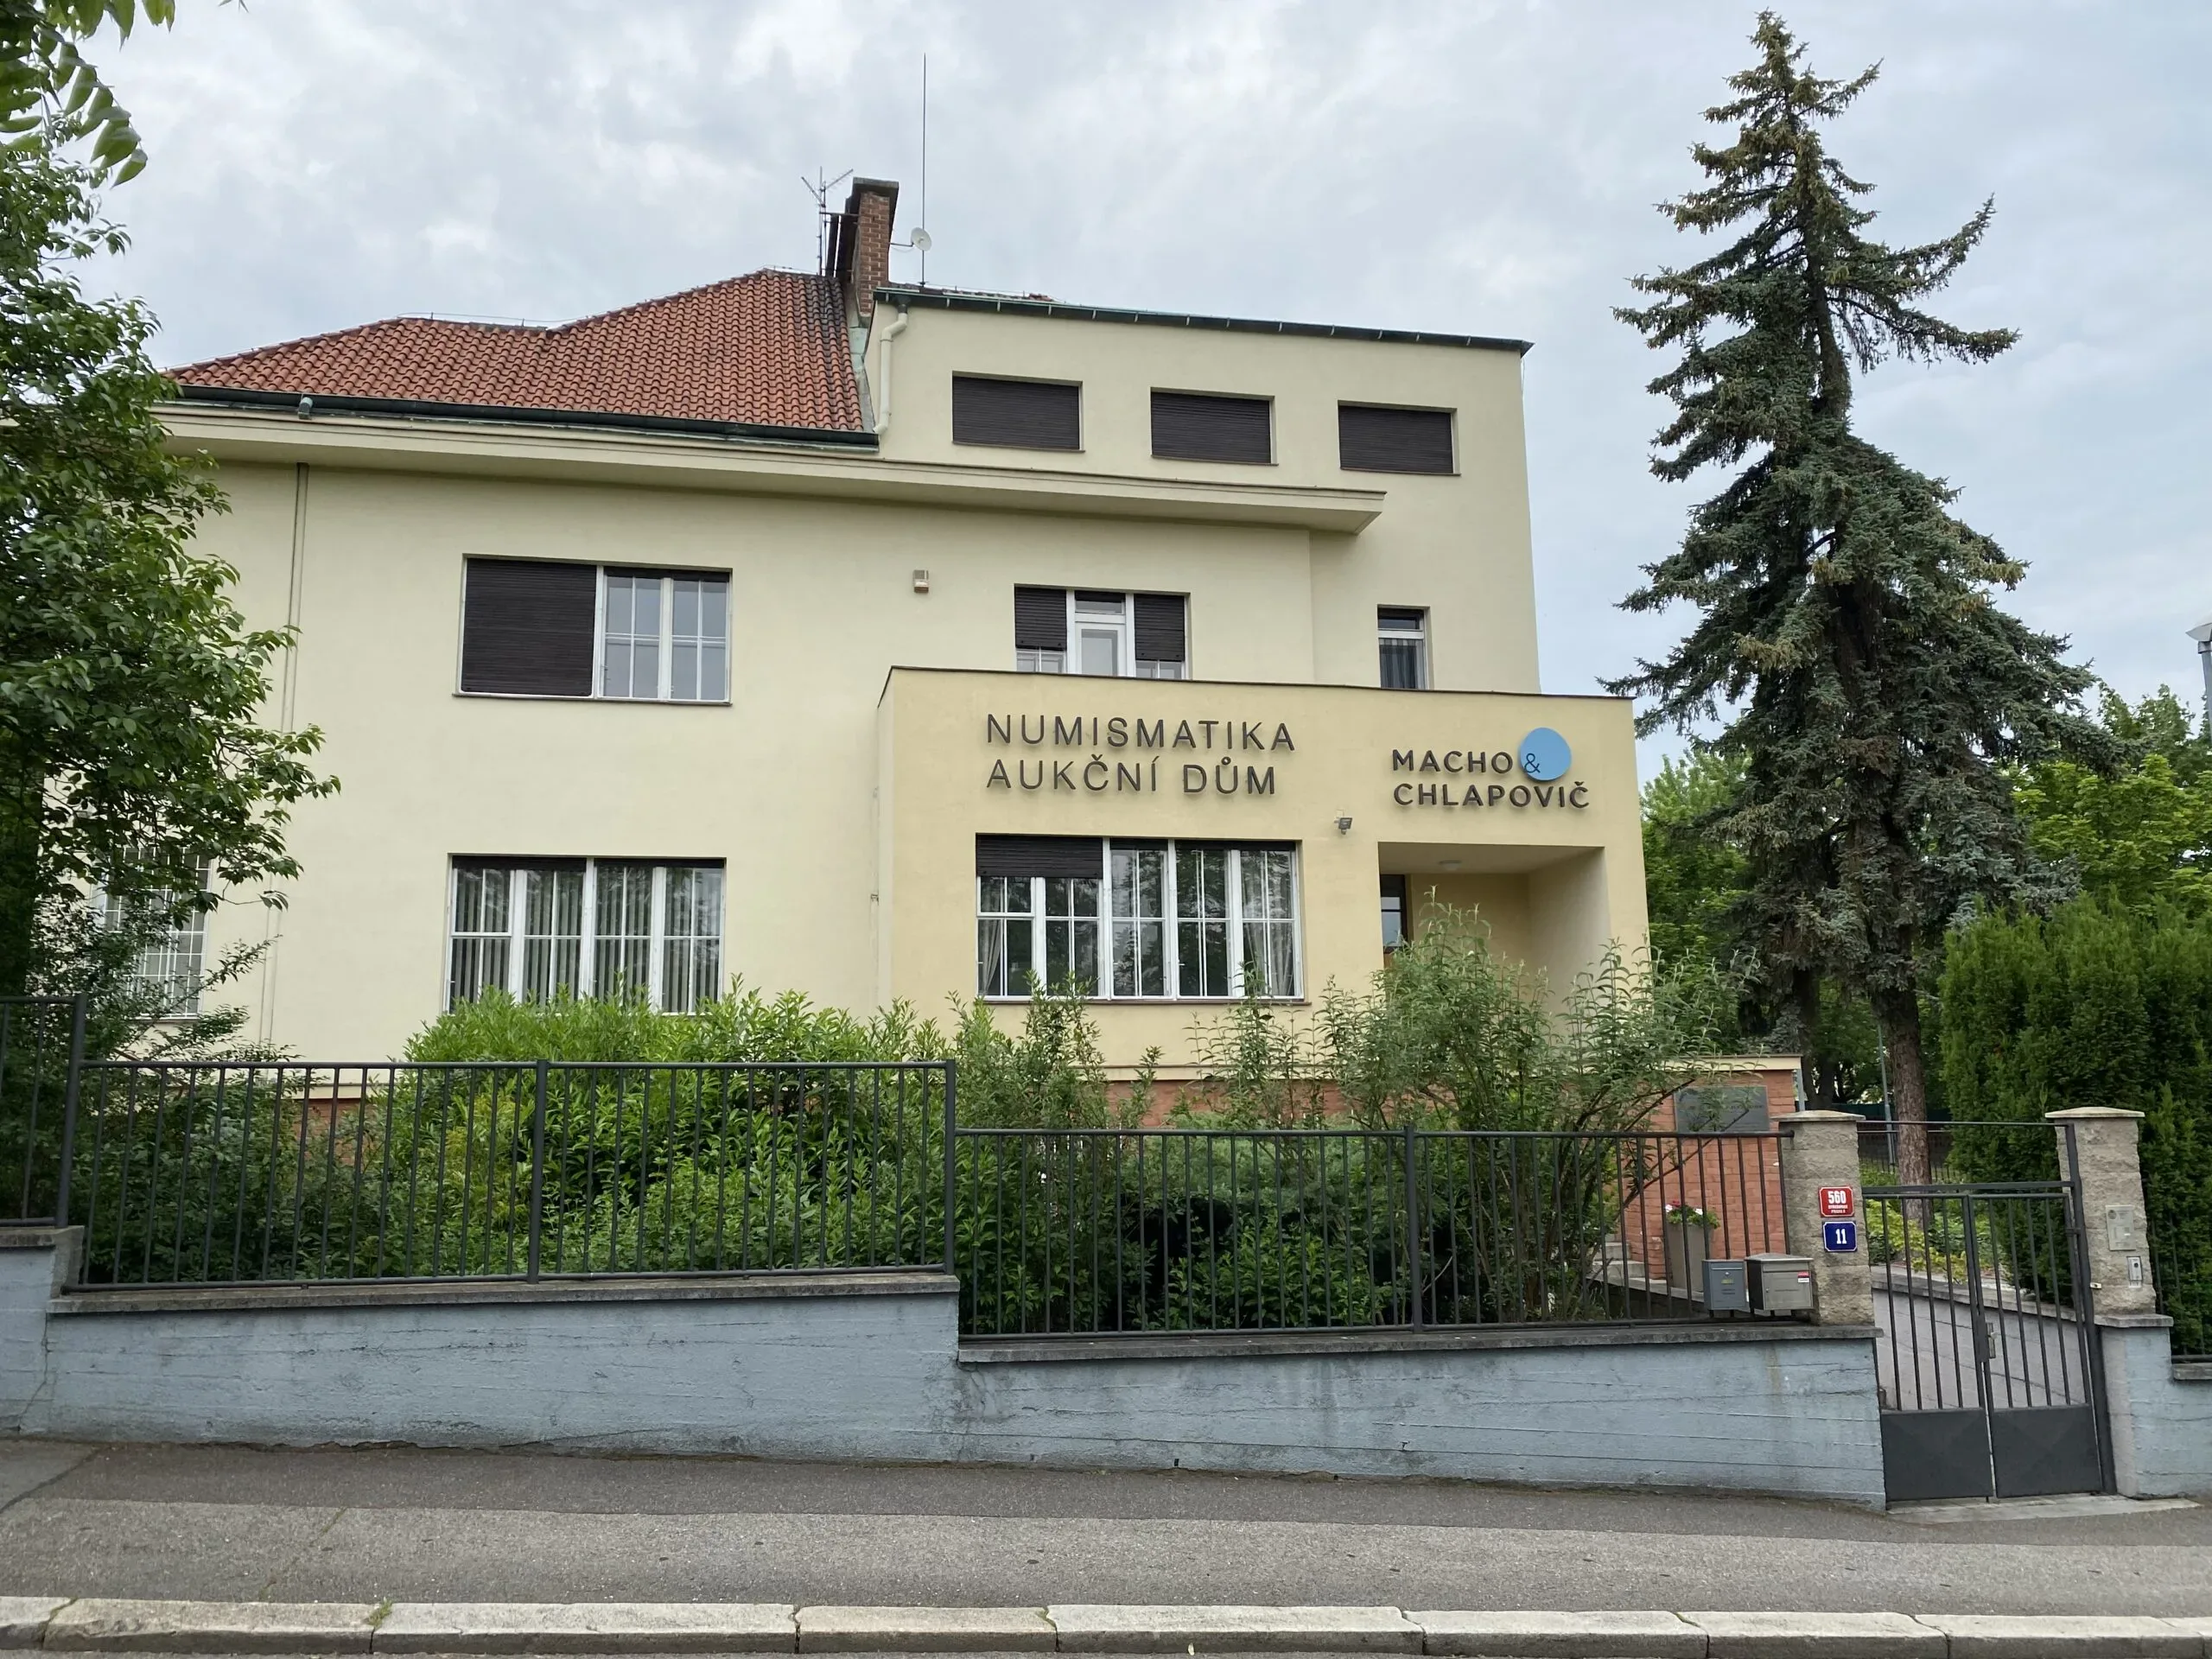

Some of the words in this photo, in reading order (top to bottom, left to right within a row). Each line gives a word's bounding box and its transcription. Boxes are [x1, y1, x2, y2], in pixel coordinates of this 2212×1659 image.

[988, 714, 1295, 751] NUMISMATIKA
[987, 753, 1160, 791] AUKČNÍ
[1183, 756, 1275, 795] DŮM
[1392, 749, 1514, 774] MACHO
[1523, 753, 1541, 774] &
[1393, 781, 1590, 809] CHLAPOVIČ
[1827, 1190, 1847, 1204] 560
[1835, 1228, 1847, 1244] 11
